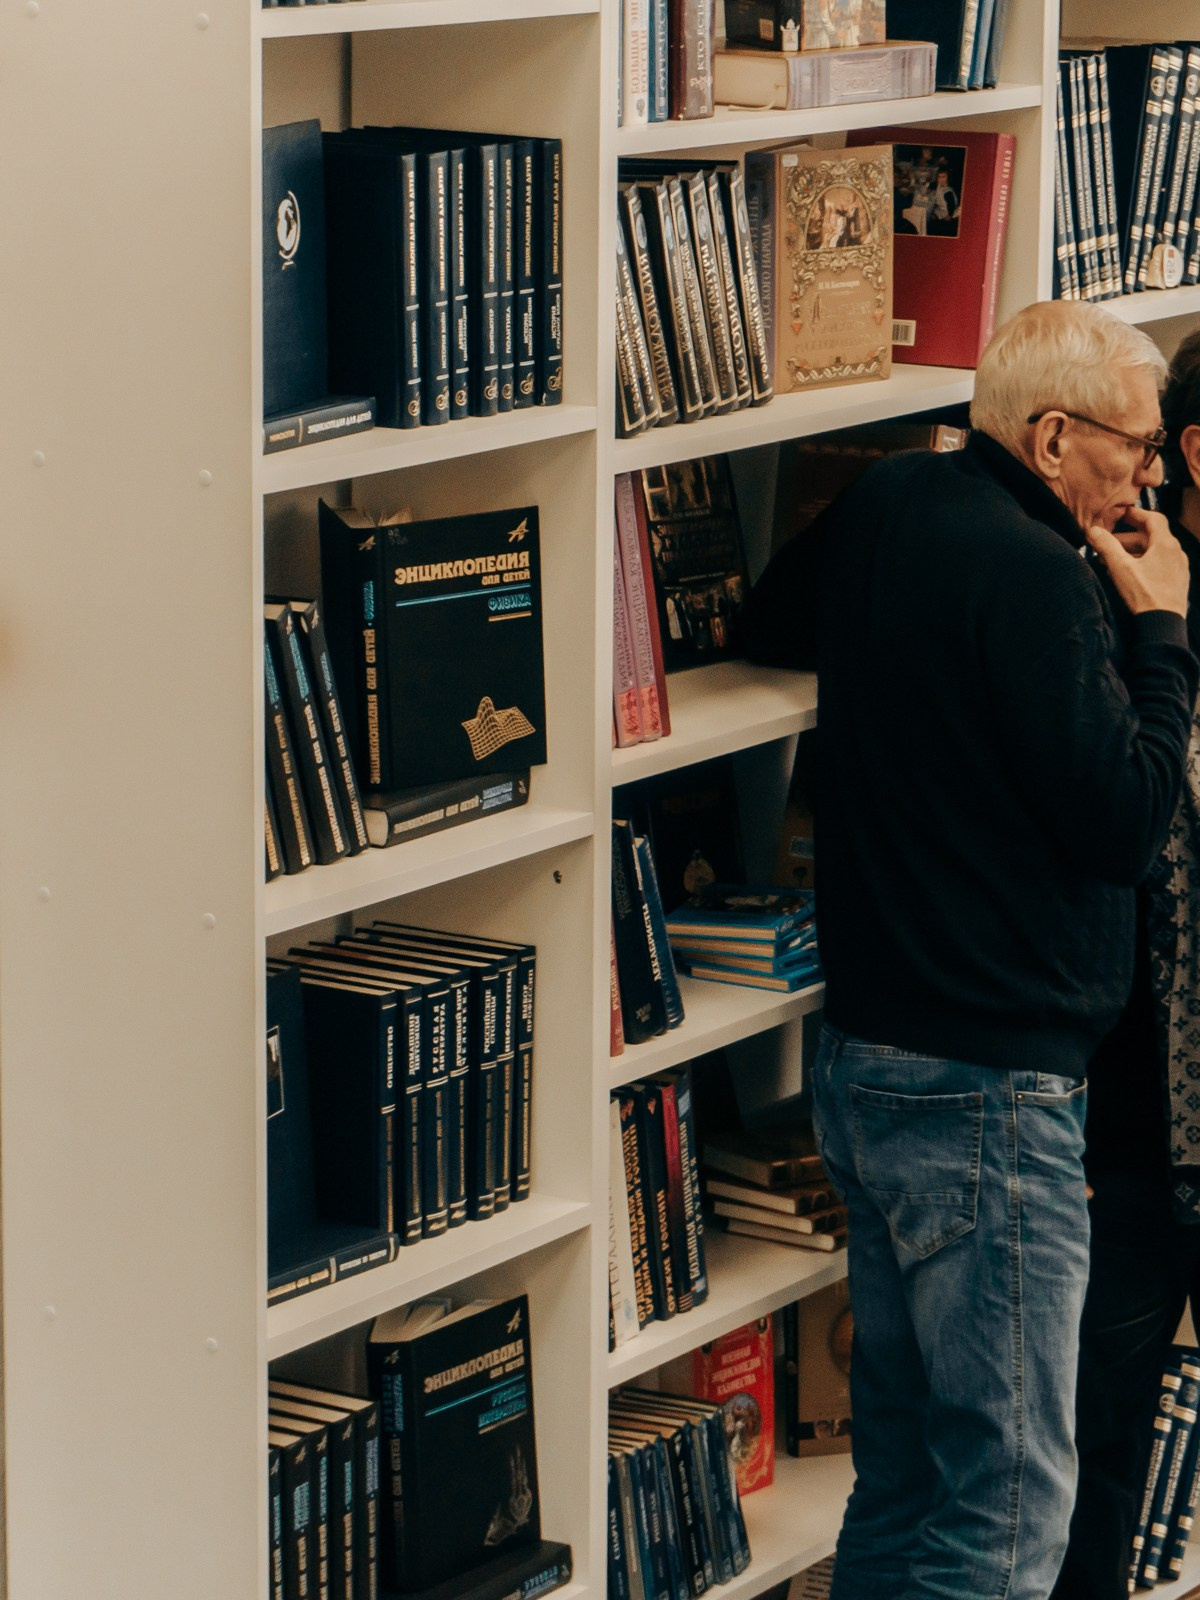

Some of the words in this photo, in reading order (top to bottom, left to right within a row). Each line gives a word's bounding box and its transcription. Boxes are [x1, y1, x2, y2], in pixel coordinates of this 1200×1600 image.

[697, 41, 706, 71] КТО
[761, 223, 772, 269] НАРОДА
[394, 550, 530, 585] ЭНЦИКЛОПЕДИЯ
[481, 573, 501, 586] ДЛЯ
[502, 568, 531, 583] ДЕТЕЙ
[488, 592, 532, 612] ФИЗИКА
[363, 628, 377, 664] ДЕТЕЙ
[366, 667, 377, 690] ДЛЯ
[304, 703, 318, 740] ДЕТЕЙ
[328, 698, 342, 733] ДЕТЕЙ
[367, 693, 381, 785] ЭНЦИКЛОПЕДИЯ
[312, 740, 323, 764] ДЛЯ
[318, 765, 345, 854] ЭНЦИКЛОПЕДИЯ
[642, 902, 662, 982] ДЕКАБРИСТЫ
[432, 1005, 440, 1074] РУССКАЯ
[484, 988, 492, 1054] РОССИЙСКИЕ
[504, 971, 512, 1053] ИНФОРМАТИКА
[386, 1025, 394, 1089] ОБЩЕСТВО
[408, 1013, 416, 1076] ДОМАШНИЕ
[622, 1129, 635, 1193] РОССИИ
[628, 1123, 642, 1186] РОССИИ
[626, 1195, 640, 1255] МЕДАЛИ
[634, 1188, 647, 1246] МЕДАЛИ
[656, 1188, 670, 1252] РОССИИ
[685, 1220, 700, 1280] БОЛЬШАЯ
[634, 1267, 647, 1323] ОРДЕНА
[641, 1259, 654, 1316] ОРДЕНА
[663, 1256, 676, 1313] ОРУЖИЕ
[423, 1338, 525, 1394] ЭНЦИКЛОПЕДИЯ
